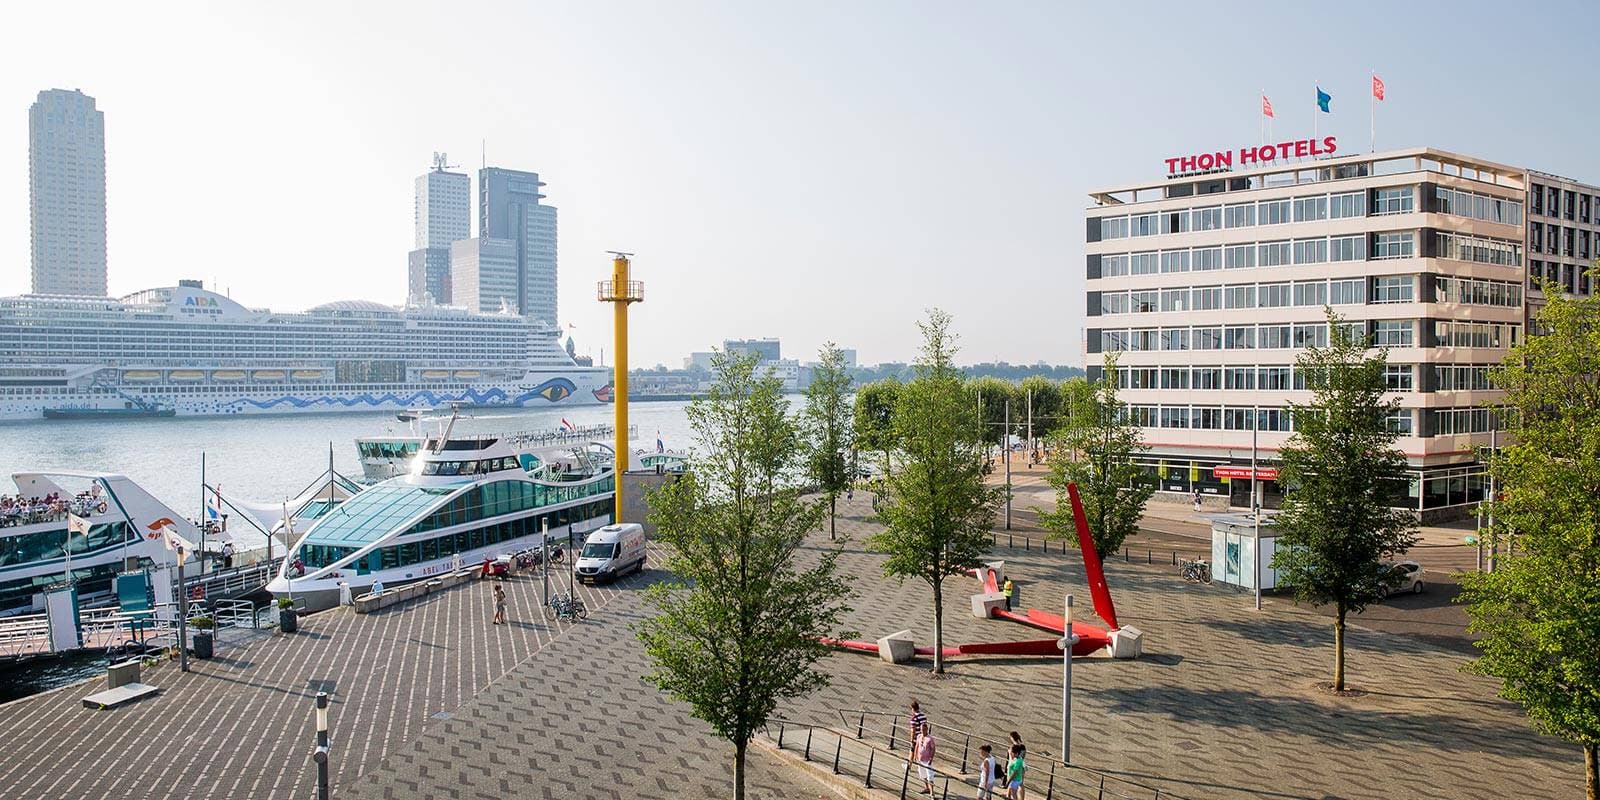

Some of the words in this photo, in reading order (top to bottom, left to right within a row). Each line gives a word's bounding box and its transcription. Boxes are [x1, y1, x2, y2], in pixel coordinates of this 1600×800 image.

[1165, 150, 1232, 174] THON
[1241, 136, 1337, 164] HOTELS
[185, 296, 218, 307] AIDA
[423, 566, 439, 575] ABEL
